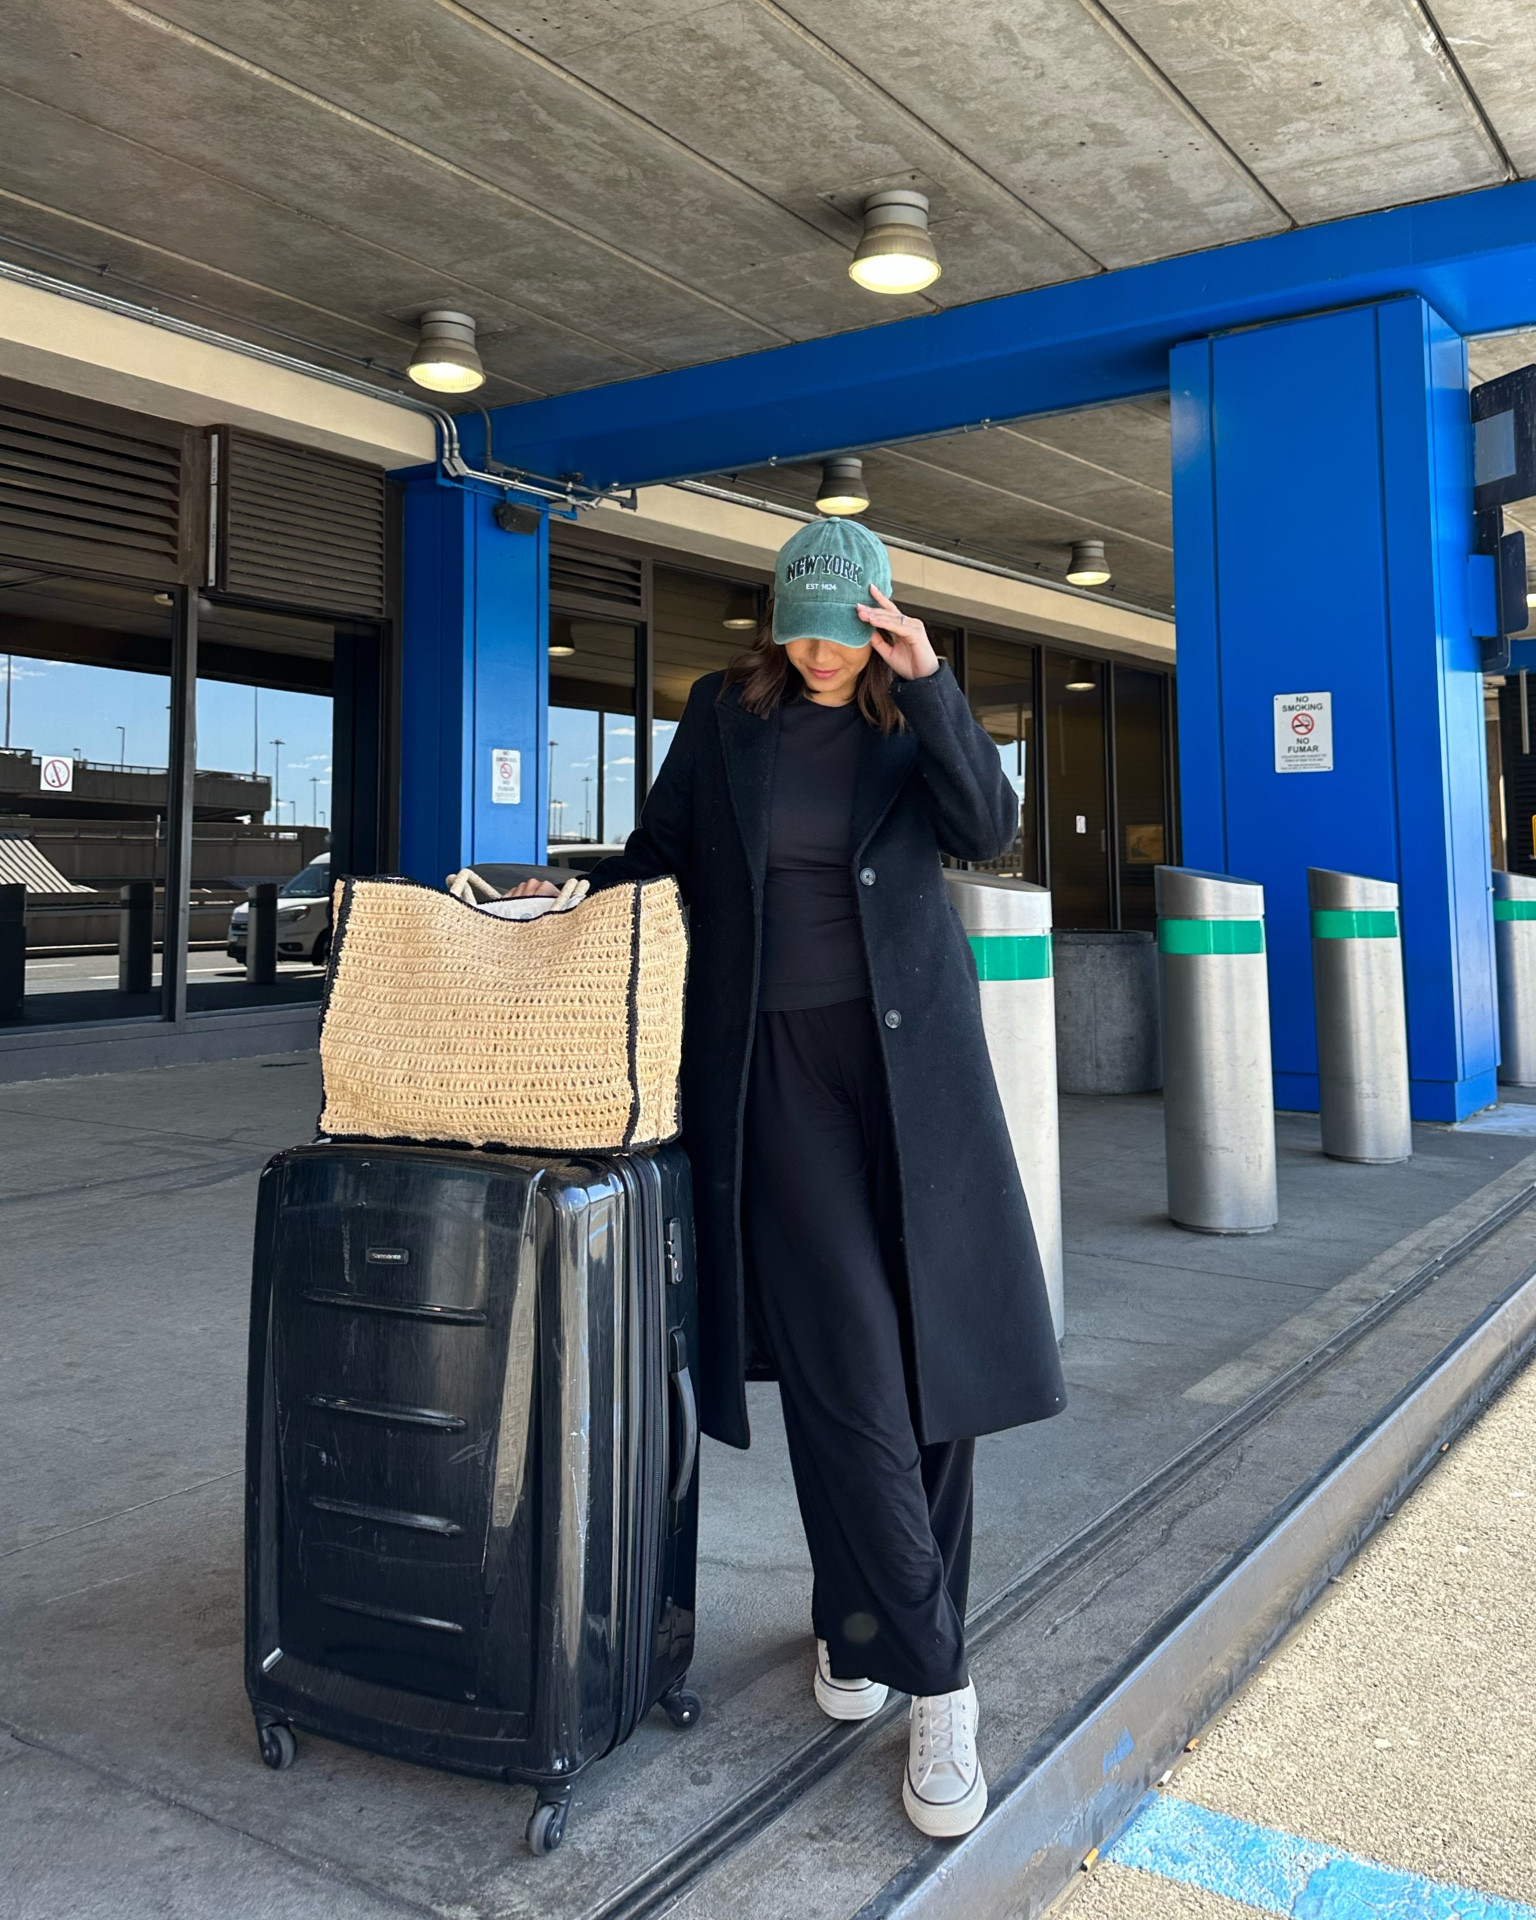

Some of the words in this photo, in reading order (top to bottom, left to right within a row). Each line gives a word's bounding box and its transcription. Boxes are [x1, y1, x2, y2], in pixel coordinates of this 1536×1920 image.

[785, 554, 820, 585] NEW
[820, 554, 863, 588] YORK
[1295, 695, 1309, 703] NO
[1282, 702, 1323, 712] SMOKING
[1296, 737, 1310, 745] NO
[1287, 744, 1319, 754] FUMAR
